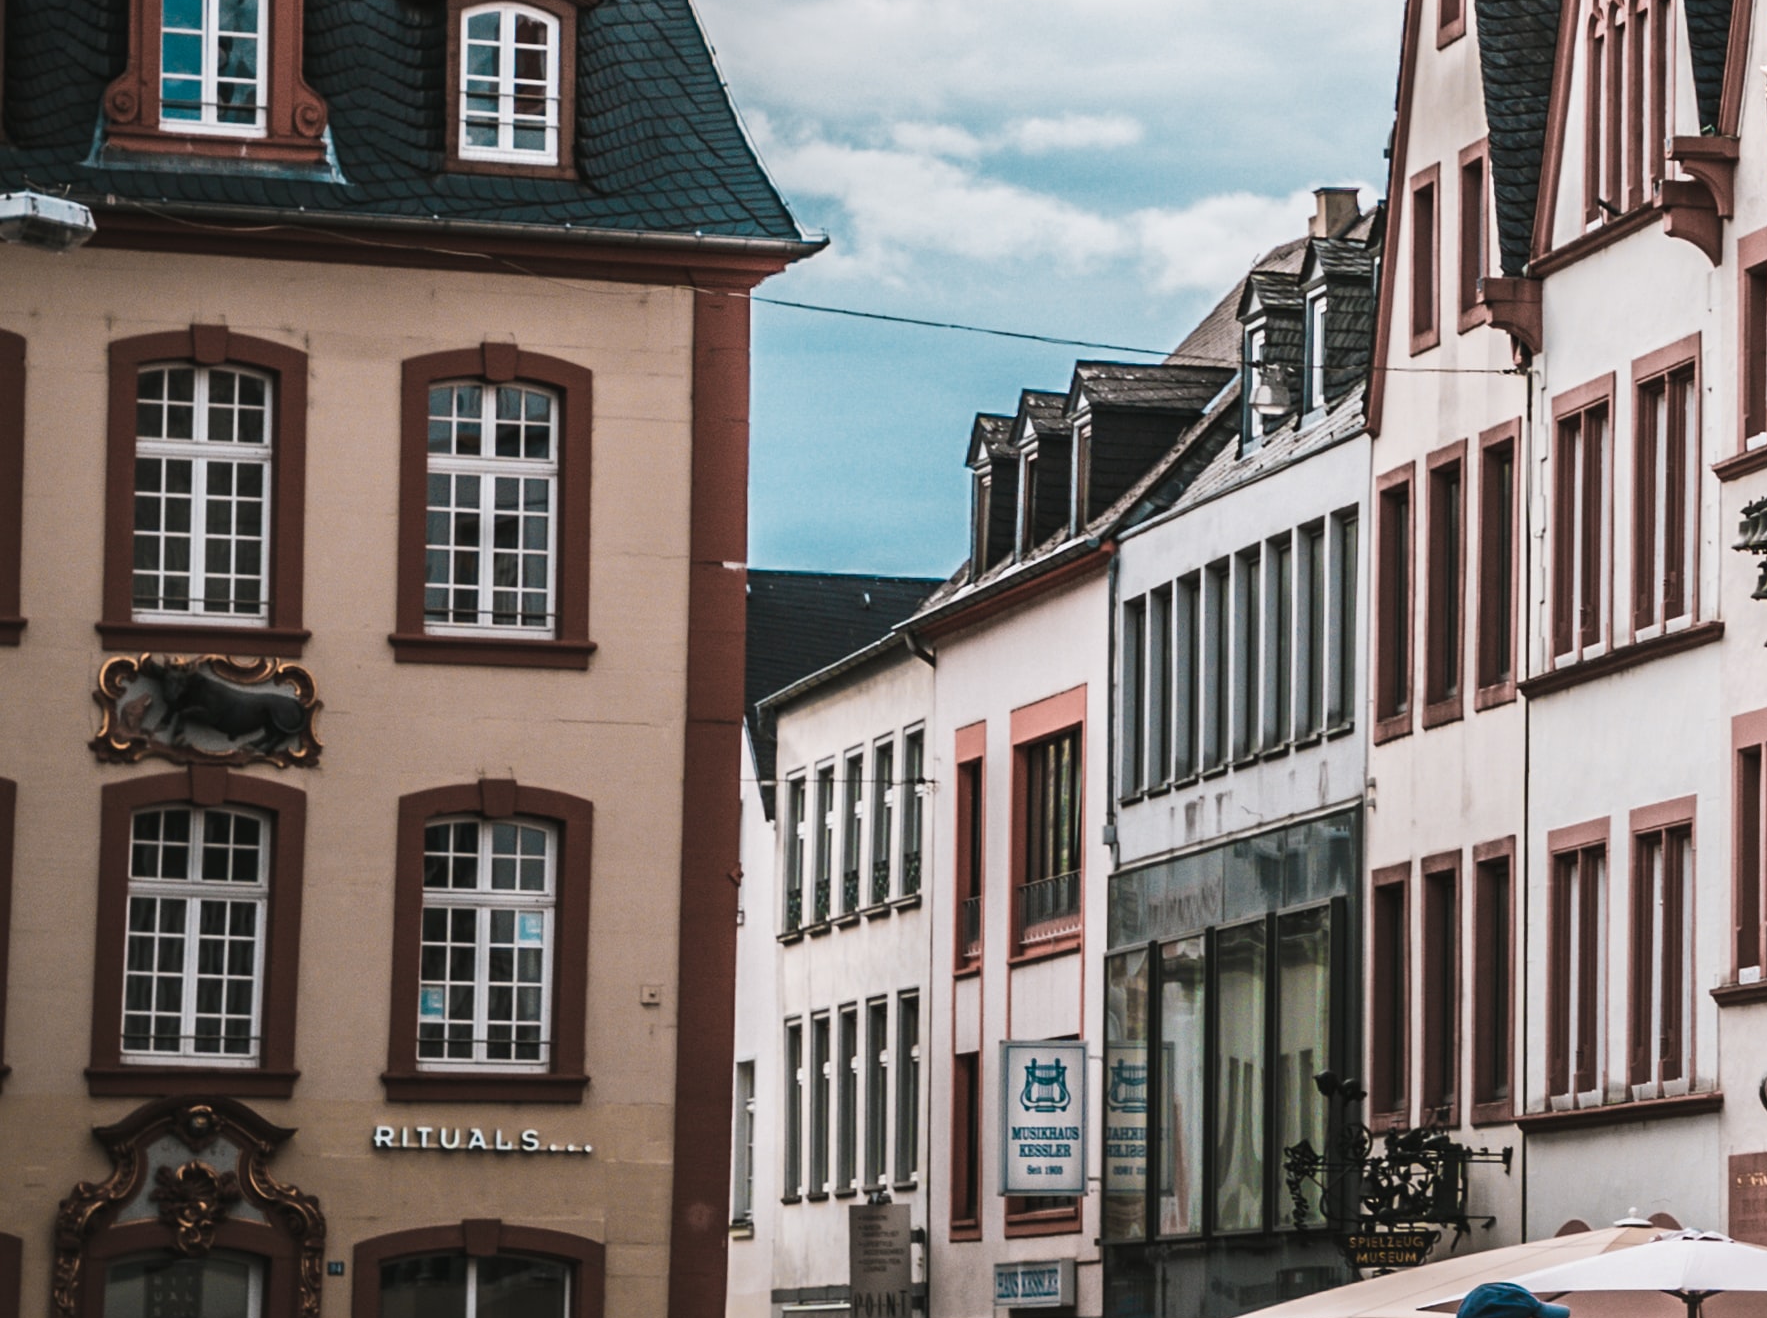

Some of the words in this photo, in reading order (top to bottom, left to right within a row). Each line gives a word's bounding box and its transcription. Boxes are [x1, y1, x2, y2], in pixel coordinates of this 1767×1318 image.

[1011, 1126, 1080, 1140] MUSIKHAUS
[1018, 1144, 1071, 1157] KESSLER
[1349, 1235, 1425, 1249] SPIELZEUG
[1355, 1250, 1418, 1264] MUSEUM
